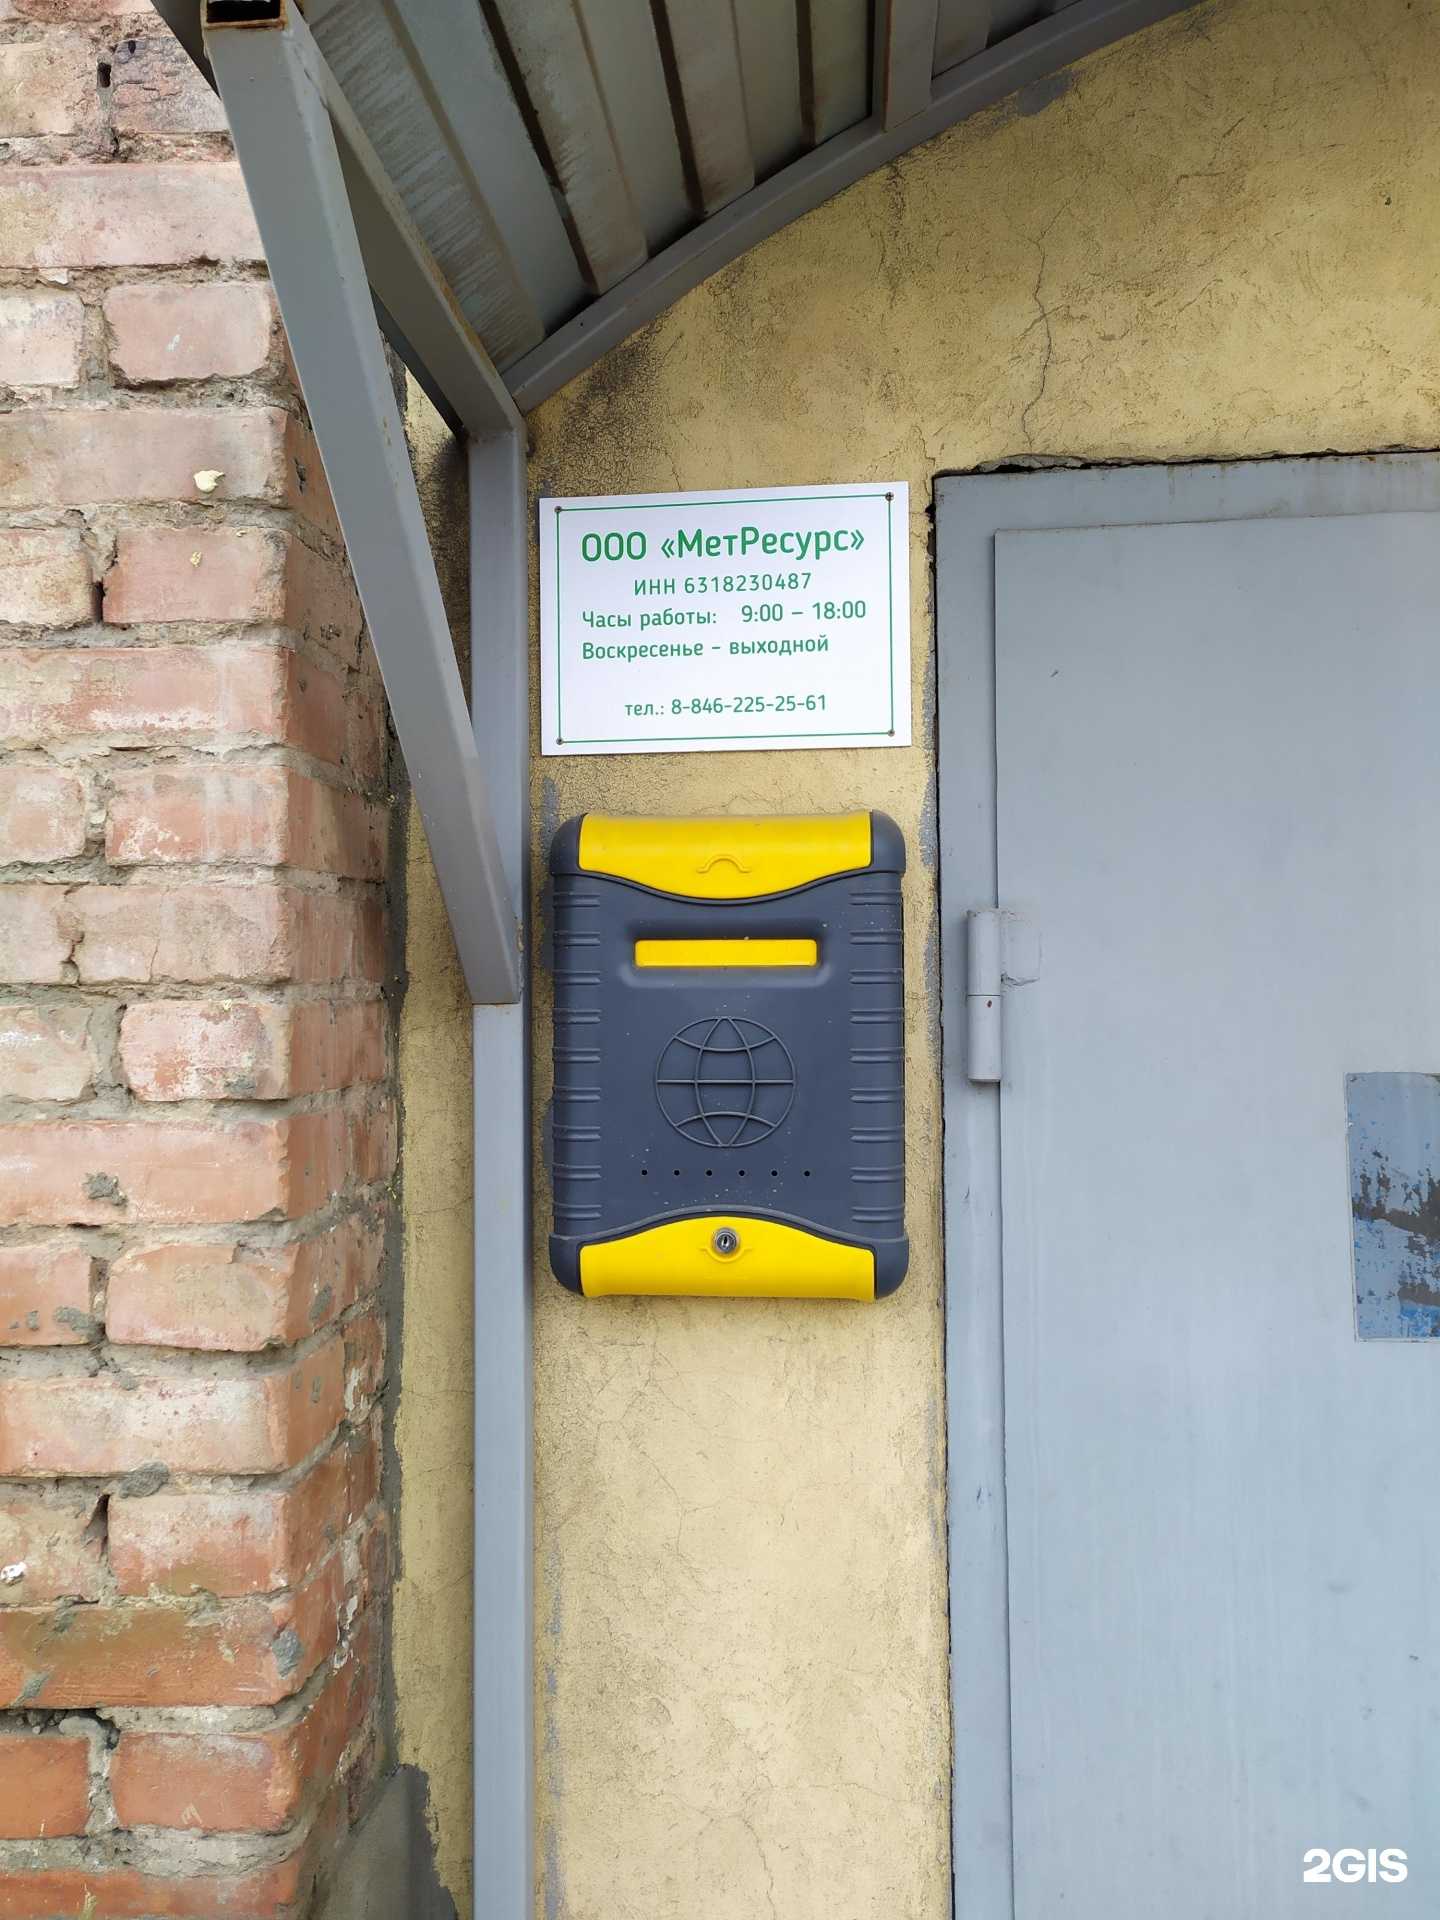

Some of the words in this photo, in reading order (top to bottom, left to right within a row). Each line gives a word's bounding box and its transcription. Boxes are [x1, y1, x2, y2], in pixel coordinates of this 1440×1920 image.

[580, 531, 647, 562] ООО
[660, 526, 865, 560] «МетРесурс»
[634, 577, 676, 596] ИНН
[684, 572, 812, 594] 6318230487
[582, 610, 632, 628] Часы
[640, 607, 717, 631] работы:
[741, 604, 784, 623] 9:00
[811, 600, 867, 620] 18:00
[582, 642, 704, 663] Воскресенье
[729, 634, 829, 656] выходной
[624, 703, 665, 716] тел.:
[671, 694, 827, 715] 8-846-225-25-61
